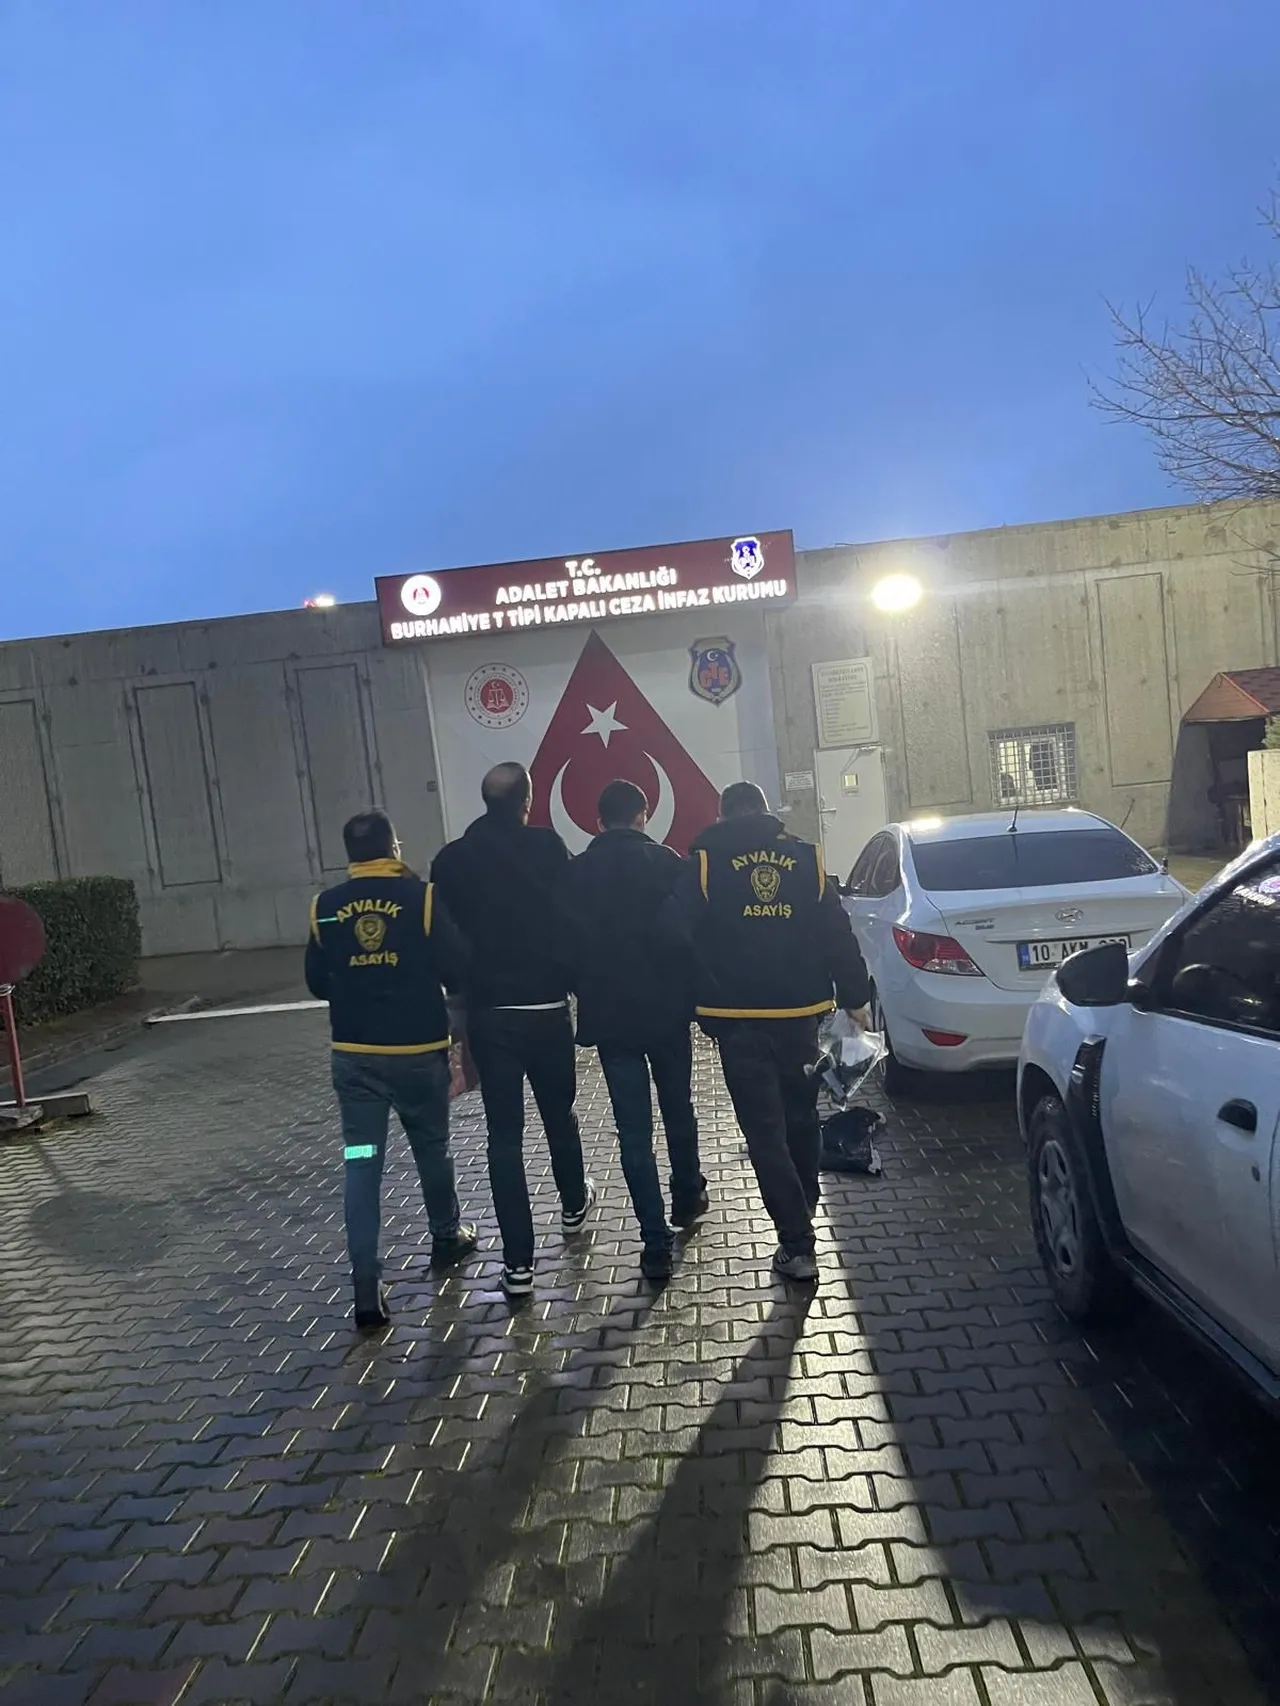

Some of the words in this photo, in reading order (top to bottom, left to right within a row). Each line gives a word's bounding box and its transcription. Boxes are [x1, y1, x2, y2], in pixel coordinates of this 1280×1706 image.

[565, 558, 602, 578] T.C.
[495, 580, 569, 605] ADALET
[573, 566, 678, 597] BAKANLIĞI
[390, 612, 491, 640] BURHANİYE
[493, 611, 504, 628] T
[507, 604, 541, 627] TİPİ
[544, 599, 606, 623] KAPALI
[609, 593, 657, 616] CEZA
[658, 588, 711, 610] İNFAZ
[712, 579, 787, 604] KURUMU
[731, 850, 797, 871] AYVALIK
[336, 899, 402, 923] AYVALIK
[743, 902, 793, 919] ASAYİŞ
[349, 950, 398, 966] ASAYİŞ
[1032, 944, 1050, 962] 10
